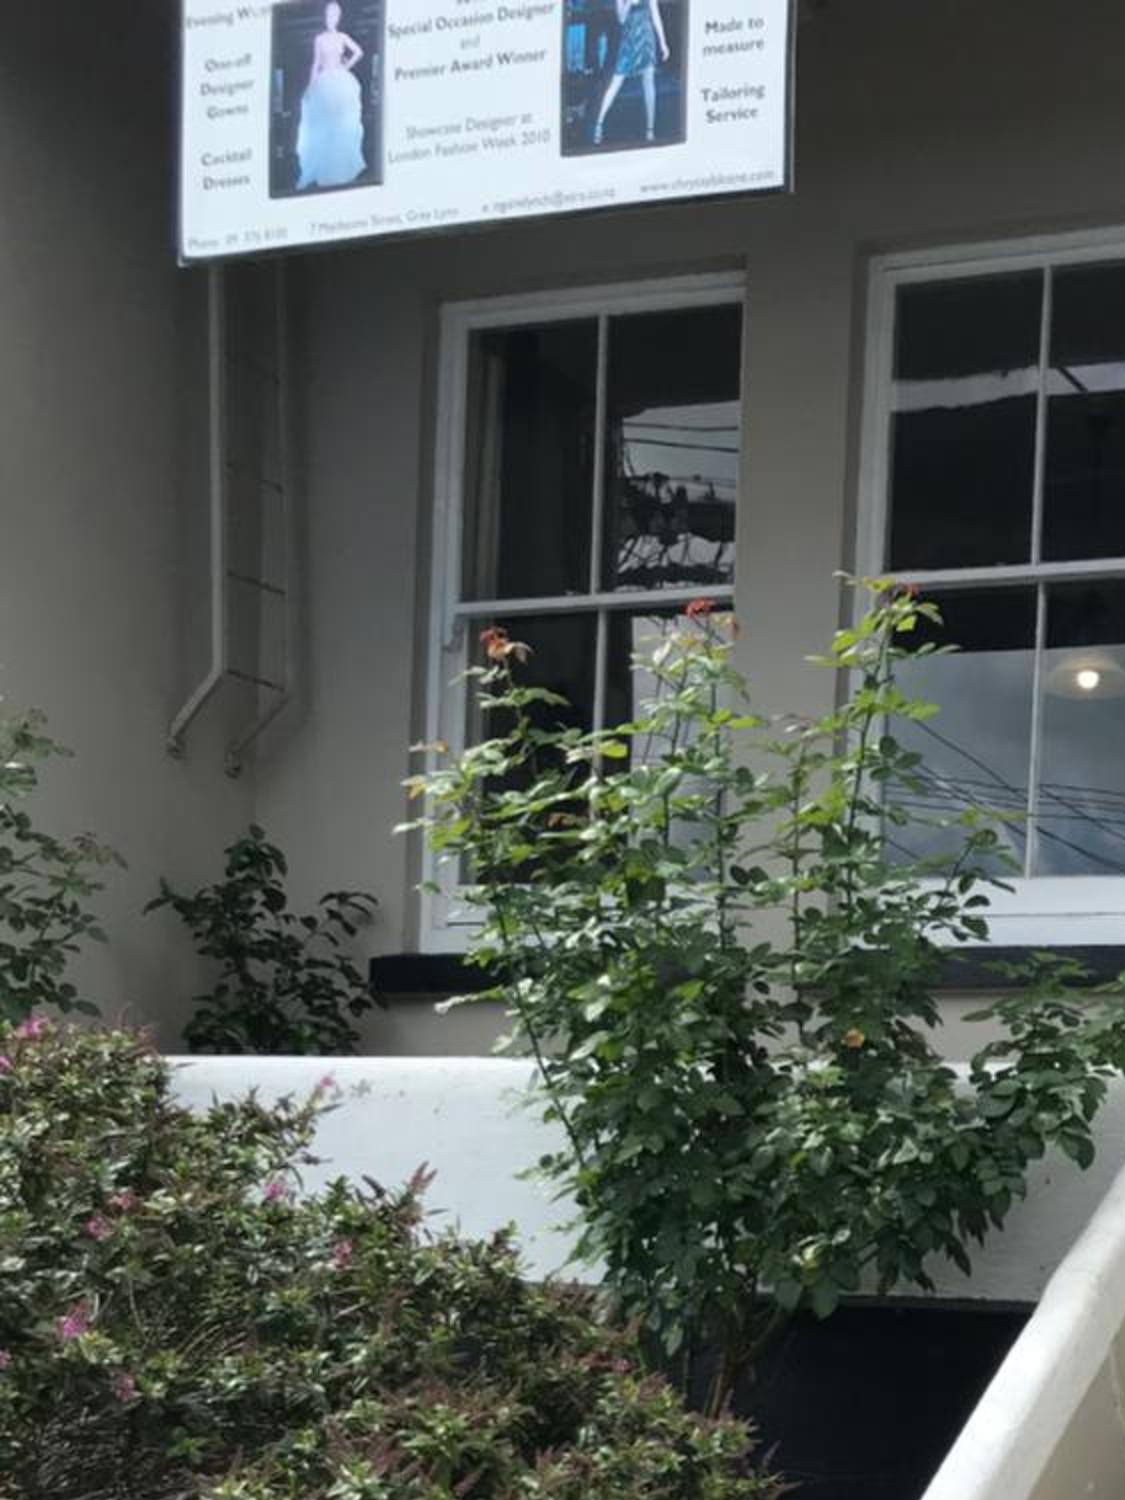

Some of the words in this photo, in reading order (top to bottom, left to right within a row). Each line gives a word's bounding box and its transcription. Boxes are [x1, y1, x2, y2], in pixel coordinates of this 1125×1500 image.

[387, 19, 433, 40] Special
[435, 12, 495, 32] Occasion
[497, 2, 556, 22] Designer
[704, 17, 743, 35] Made
[747, 17, 765, 31] to
[459, 34, 481, 50] and
[702, 40, 765, 57] measure
[394, 65, 446, 82] Premier
[450, 56, 494, 74] Award
[496, 49, 547, 66] Winner
[200, 79, 255, 98] Designer
[700, 83, 767, 102] Tailoring
[206, 104, 249, 120] Gowns
[705, 107, 759, 125] Service
[406, 123, 462, 140] Showcase
[465, 114, 518, 133] Designer
[520, 113, 534, 125] at
[387, 147, 432, 165] London
[435, 142, 479, 157] Fashion
[482, 136, 517, 150] Week
[521, 128, 552, 146] 2010
[200, 147, 253, 167] Cocktail
[202, 175, 251, 191] Dresses
